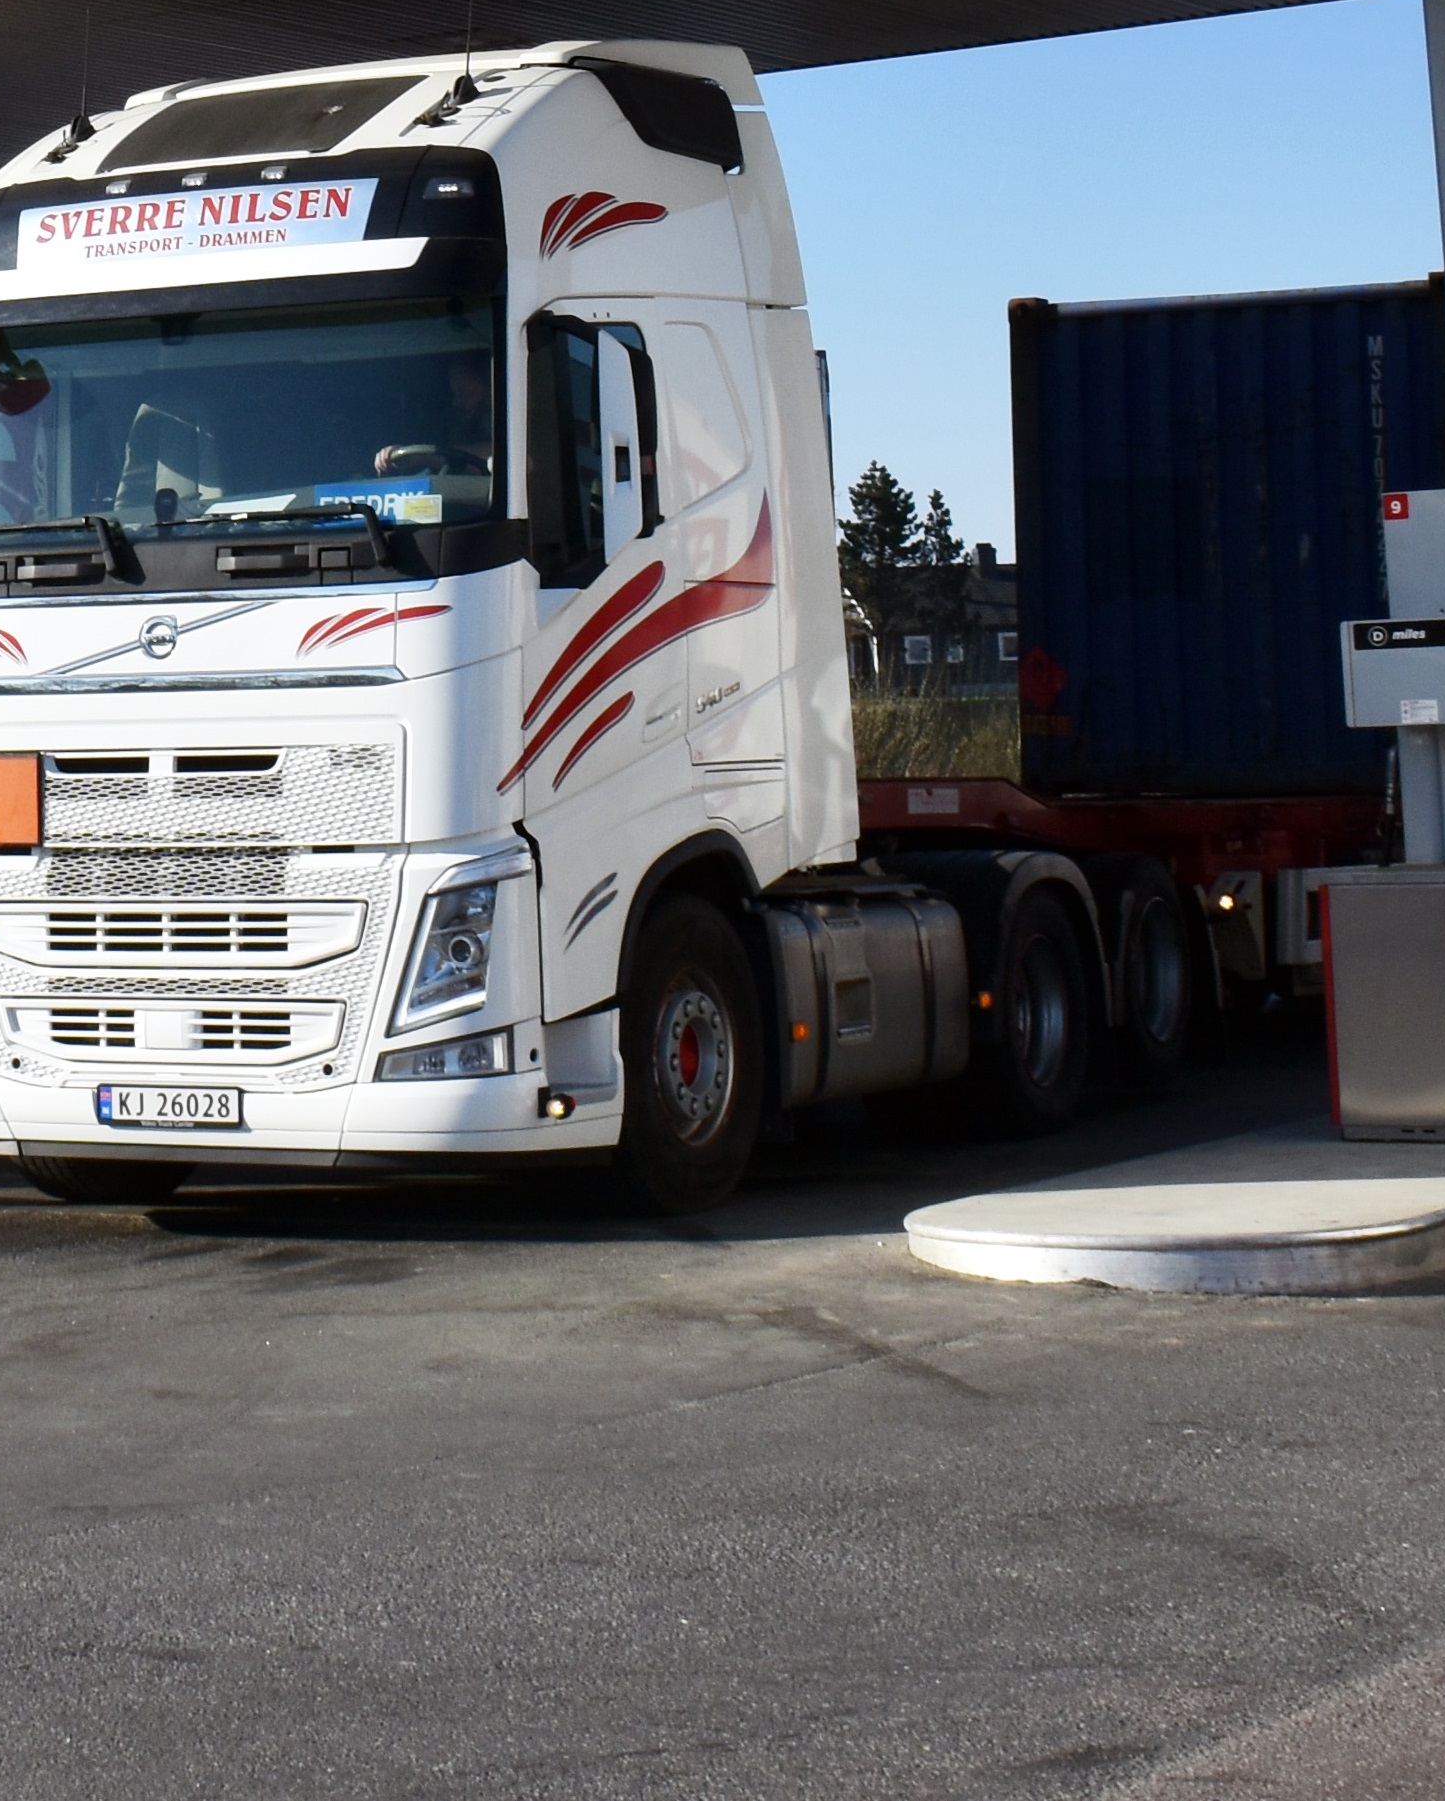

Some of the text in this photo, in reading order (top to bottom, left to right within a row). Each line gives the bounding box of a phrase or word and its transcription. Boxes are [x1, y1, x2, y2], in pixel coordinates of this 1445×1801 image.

[36, 187, 353, 244] SVERRE NILSEN
[84, 236, 184, 260] TRANSPORT
[198, 228, 287, 249] DRAMMEN
[1390, 500, 1402, 514] 9
[1392, 629, 1427, 640] miles
[118, 1091, 145, 1117] KJ
[156, 1092, 231, 1119] 26028
